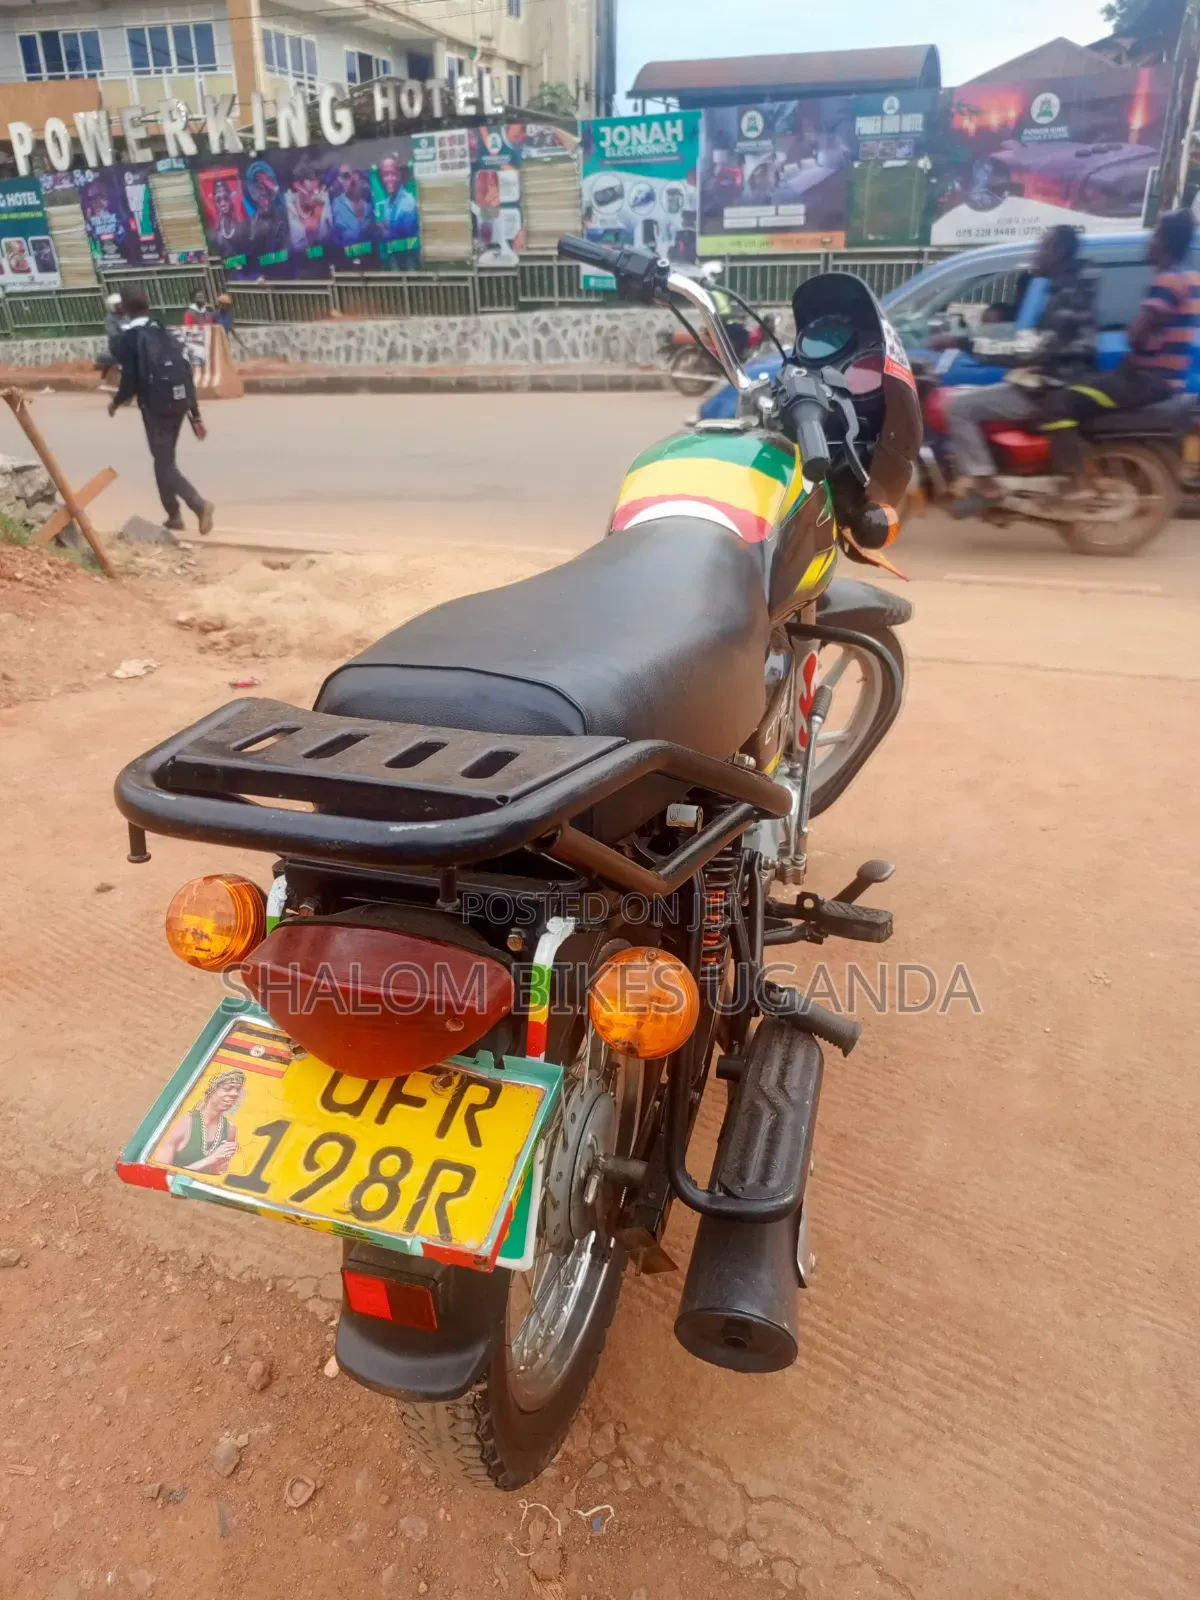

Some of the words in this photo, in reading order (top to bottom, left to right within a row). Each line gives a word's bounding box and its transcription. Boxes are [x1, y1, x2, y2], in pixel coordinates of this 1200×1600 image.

[374, 74, 504, 122] HOTEL
[599, 120, 683, 147] JONAH
[605, 141, 677, 157] ELECTRONICS
[6, 191, 40, 206] HOTEL
[321, 1064, 503, 1149] UFR
[223, 1119, 476, 1242] 198R
